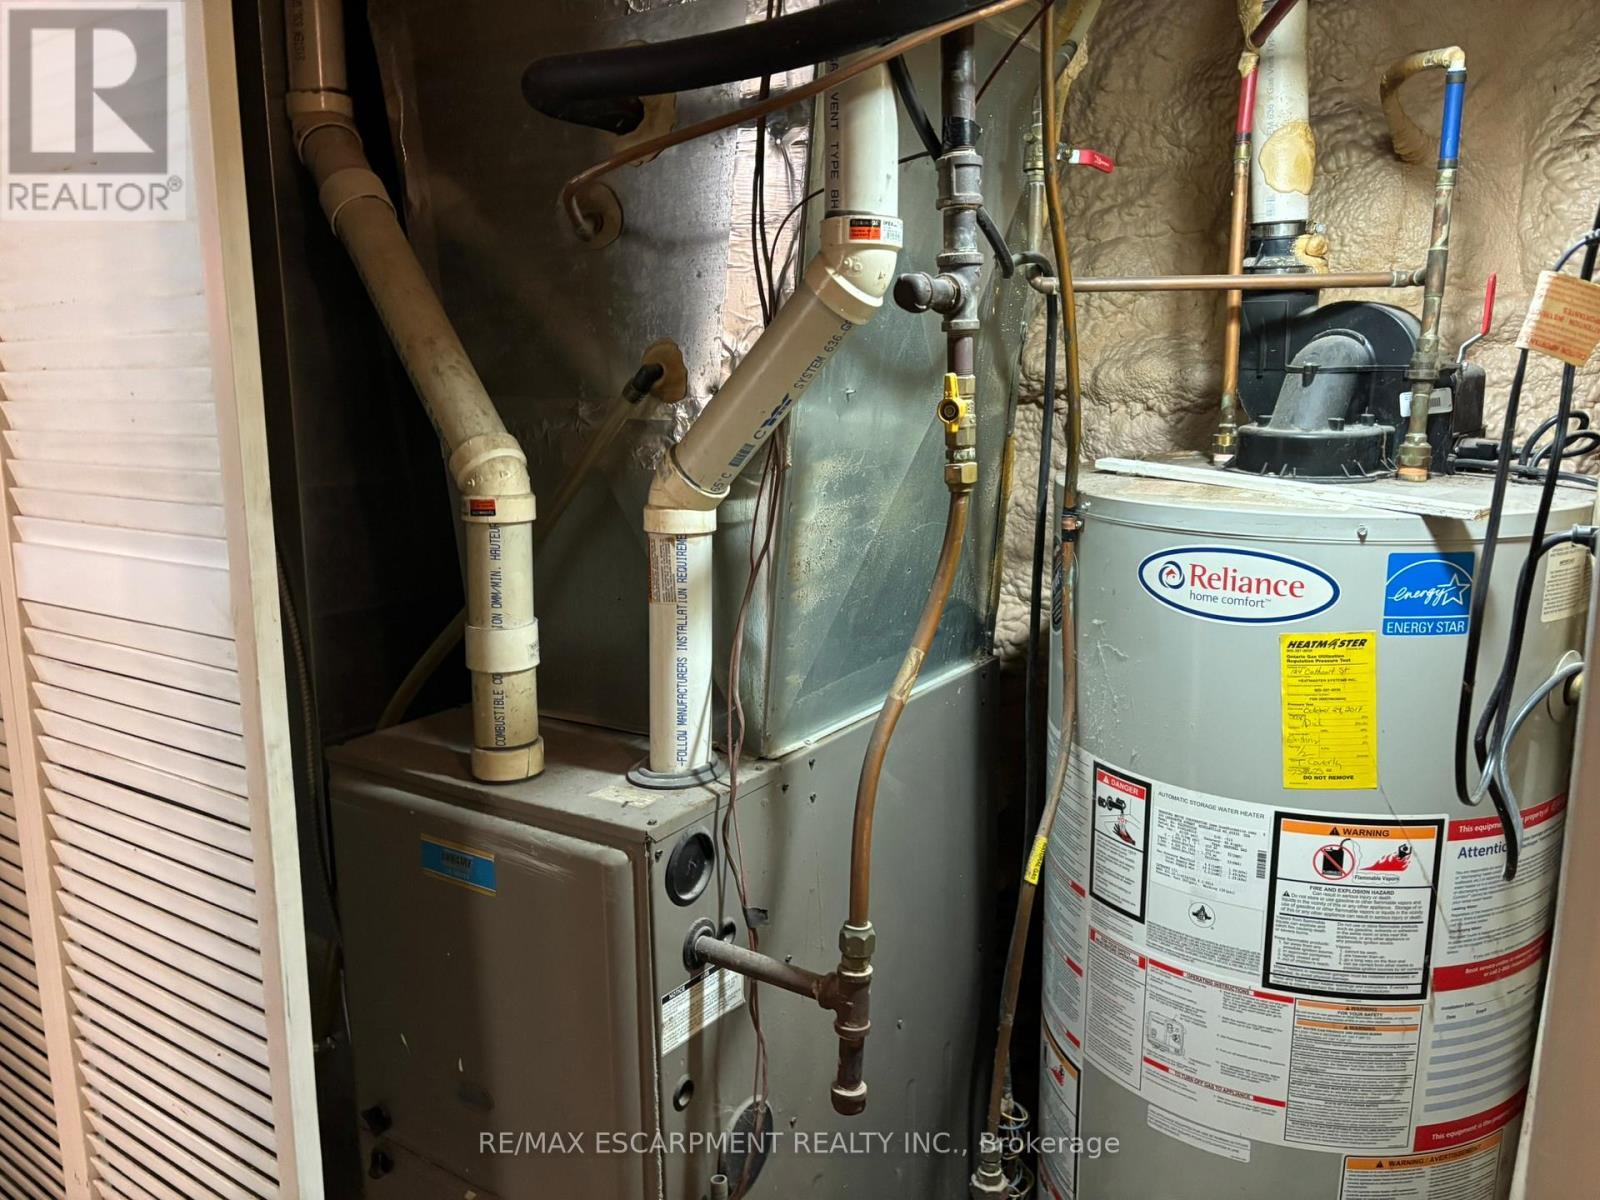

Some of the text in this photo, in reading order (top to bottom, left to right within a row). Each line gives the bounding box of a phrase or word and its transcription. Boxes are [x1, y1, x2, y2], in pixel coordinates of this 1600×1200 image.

[830, 92, 840, 209] VENT TYPE BH
[793, 355, 826, 390] SYSTEM
[824, 335, 842, 353] 636
[676, 534, 688, 584] REQUIREME
[1189, 563, 1306, 598] Reliance
[1189, 590, 1219, 604] home
[1389, 586, 1448, 607] energy
[676, 588, 688, 652] INSTALLATION
[1386, 620, 1465, 635] ENERGY STAR
[1287, 638, 1368, 650] HEATMASTER
[676, 656, 688, 725] MANUFACTURERS
[493, 688, 506, 747] COMBUSTIBLE
[1110, 778, 1139, 796] DANGER
[1158, 791, 1265, 819] AUTOMATIC STORAGE WATER HEATER
[1342, 828, 1390, 837] WARNING
[1458, 825, 1474, 833] This
[1475, 823, 1502, 833] equipm
[1432, 1132, 1445, 1140] This
[1446, 1124, 1477, 1140] equipment
[1388, 1158, 1424, 1168] WARNING
